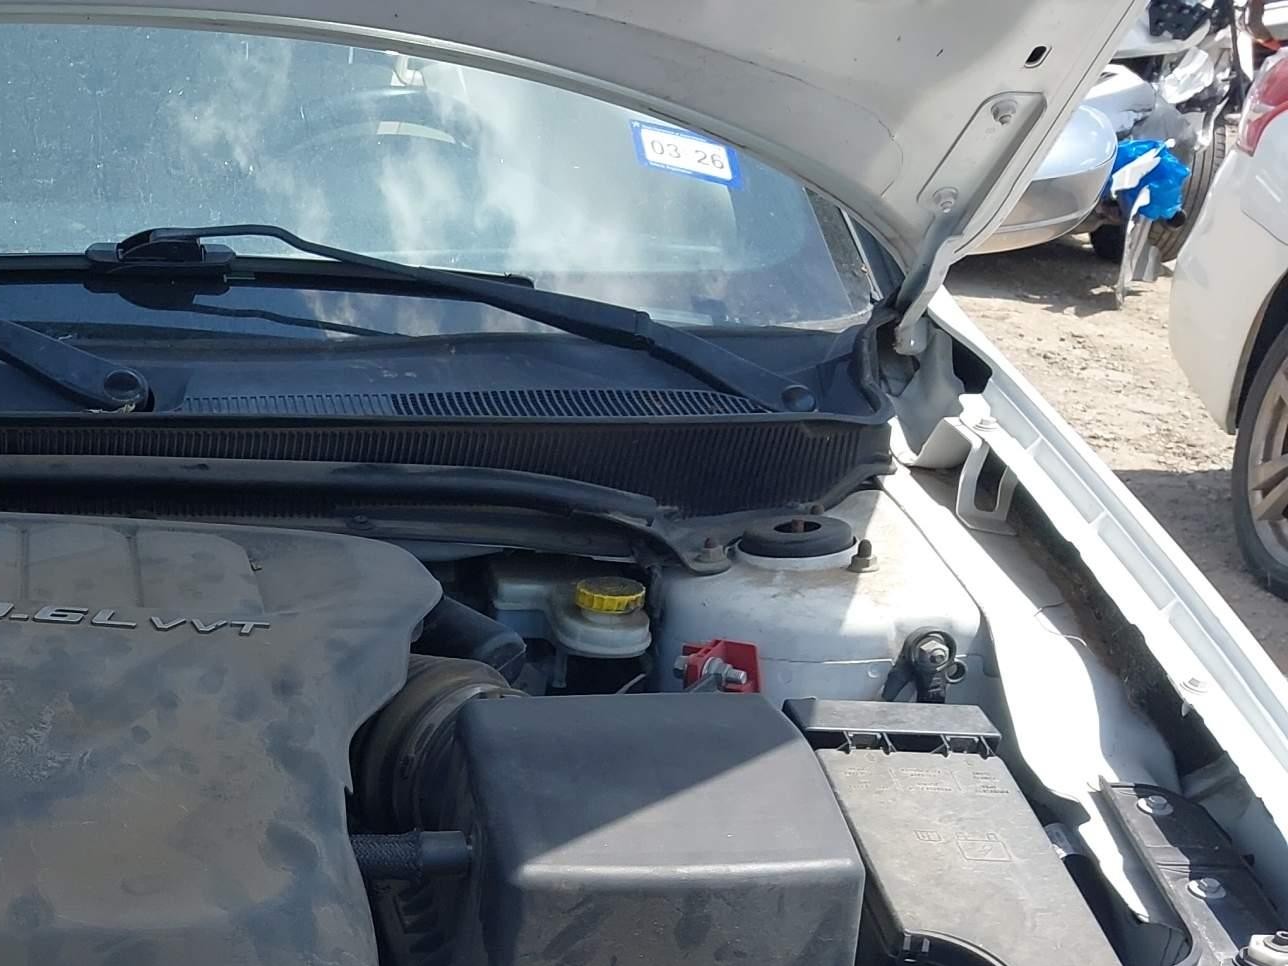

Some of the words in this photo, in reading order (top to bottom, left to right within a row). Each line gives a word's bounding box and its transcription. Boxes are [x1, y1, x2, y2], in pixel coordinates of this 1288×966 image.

[651, 140, 681, 159] 03
[694, 150, 724, 170] 26
[150, 615, 271, 636] VVT
